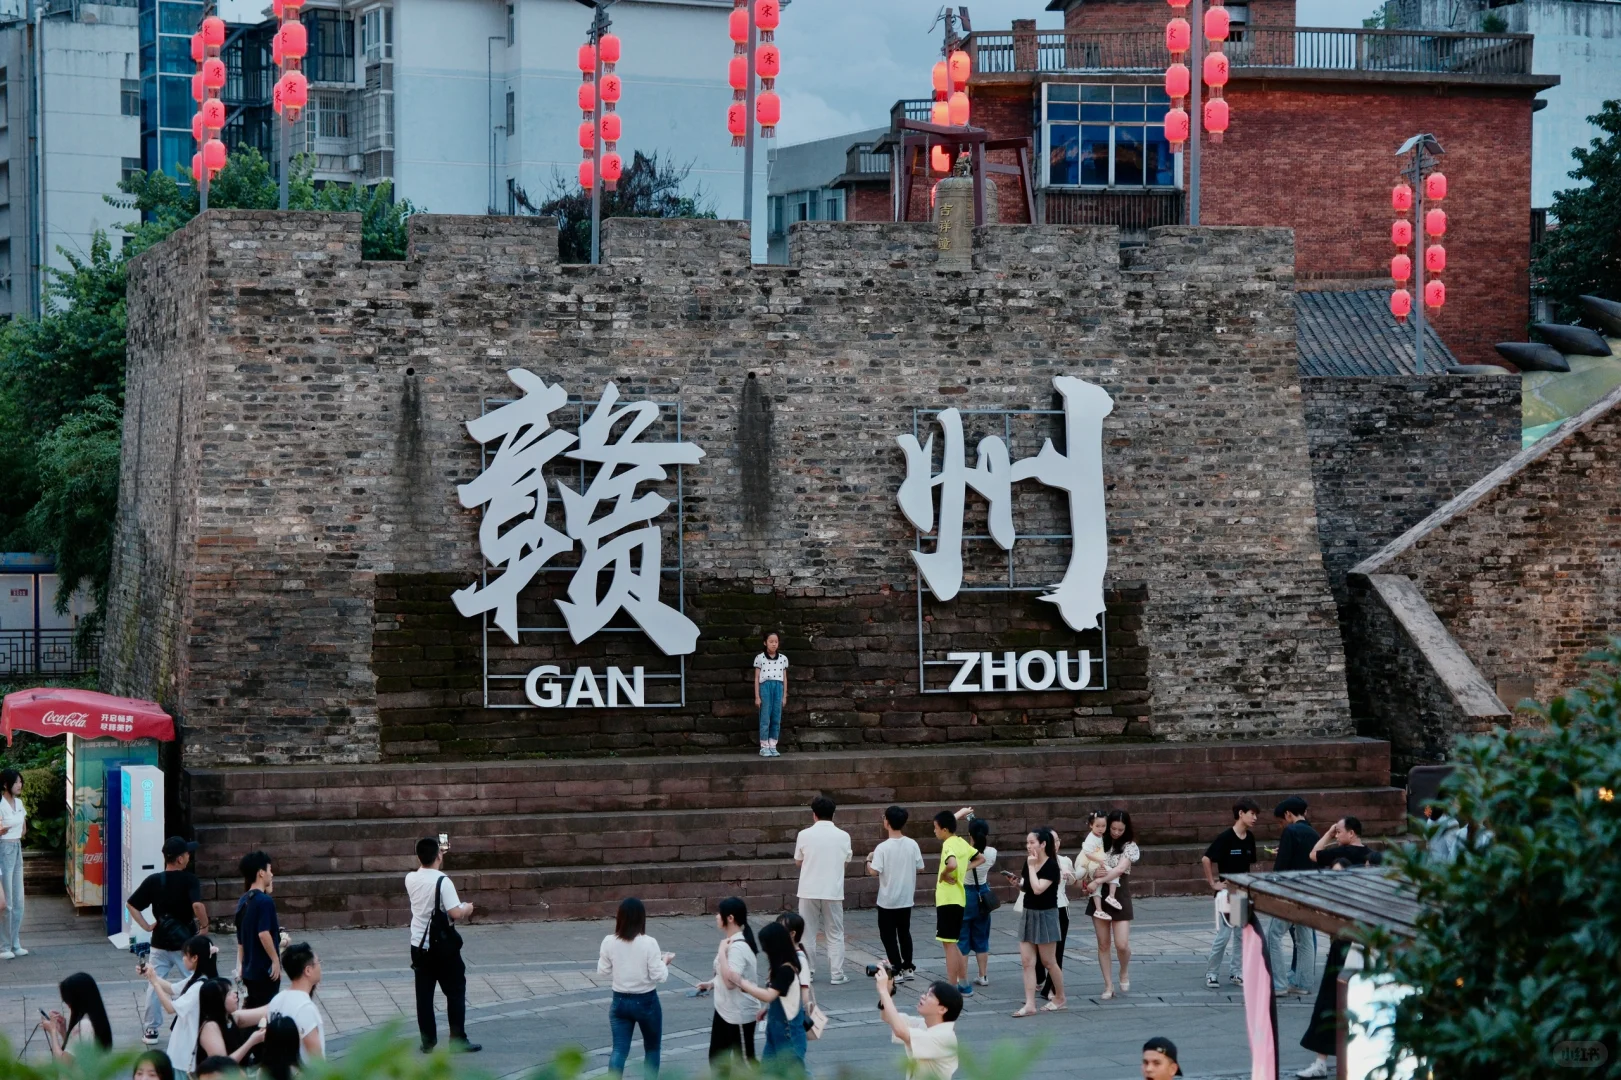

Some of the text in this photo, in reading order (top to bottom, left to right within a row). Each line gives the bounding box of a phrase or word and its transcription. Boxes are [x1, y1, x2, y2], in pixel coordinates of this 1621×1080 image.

[762, 4, 773, 18] 宋
[764, 52, 775, 66] 宋
[212, 66, 222, 78] 宋
[1217, 62, 1226, 74] 宋
[285, 81, 297, 94] 宋
[606, 80, 616, 92] 宋
[208, 106, 219, 118] 宋
[610, 160, 619, 170] 宋
[1428, 252, 1436, 264] 宋
[1434, 288, 1442, 300] 宋
[525, 650, 1091, 708] GAN ZHOU
[101, 714, 134, 723] 开启畅爽
